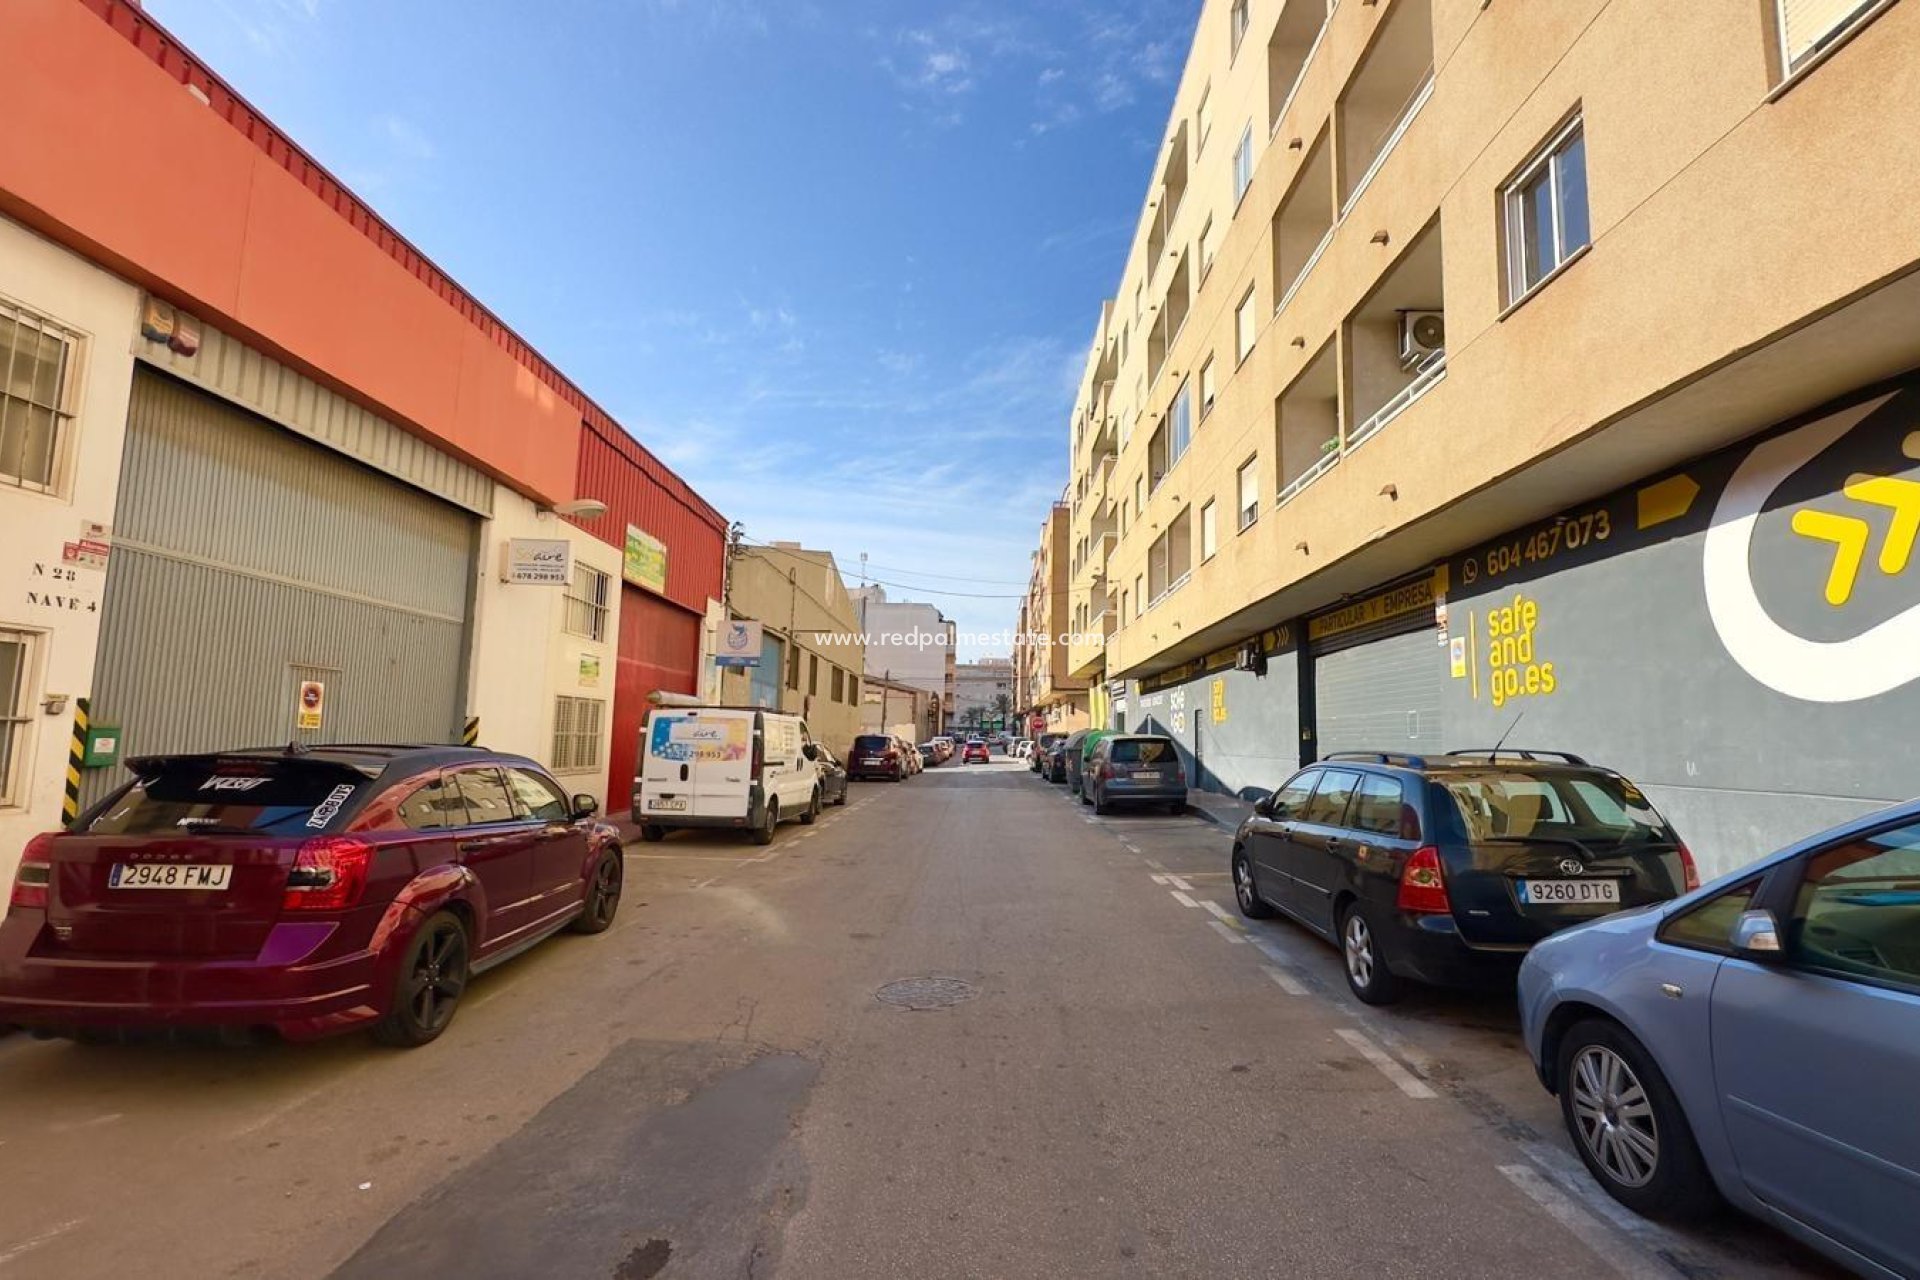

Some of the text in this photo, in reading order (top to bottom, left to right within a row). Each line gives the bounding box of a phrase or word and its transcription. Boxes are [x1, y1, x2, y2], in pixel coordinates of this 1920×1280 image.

[1486, 509, 1611, 576] 604 467 073
[27, 591, 80, 610] NAVE
[1384, 583, 1431, 613] EMPRESA
[1488, 594, 1538, 637] safe
[1489, 627, 1534, 668] and
[1491, 662, 1556, 707] go.es
[123, 865, 226, 886] 2948 FMJ
[1532, 883, 1613, 901] 9260 DTG
